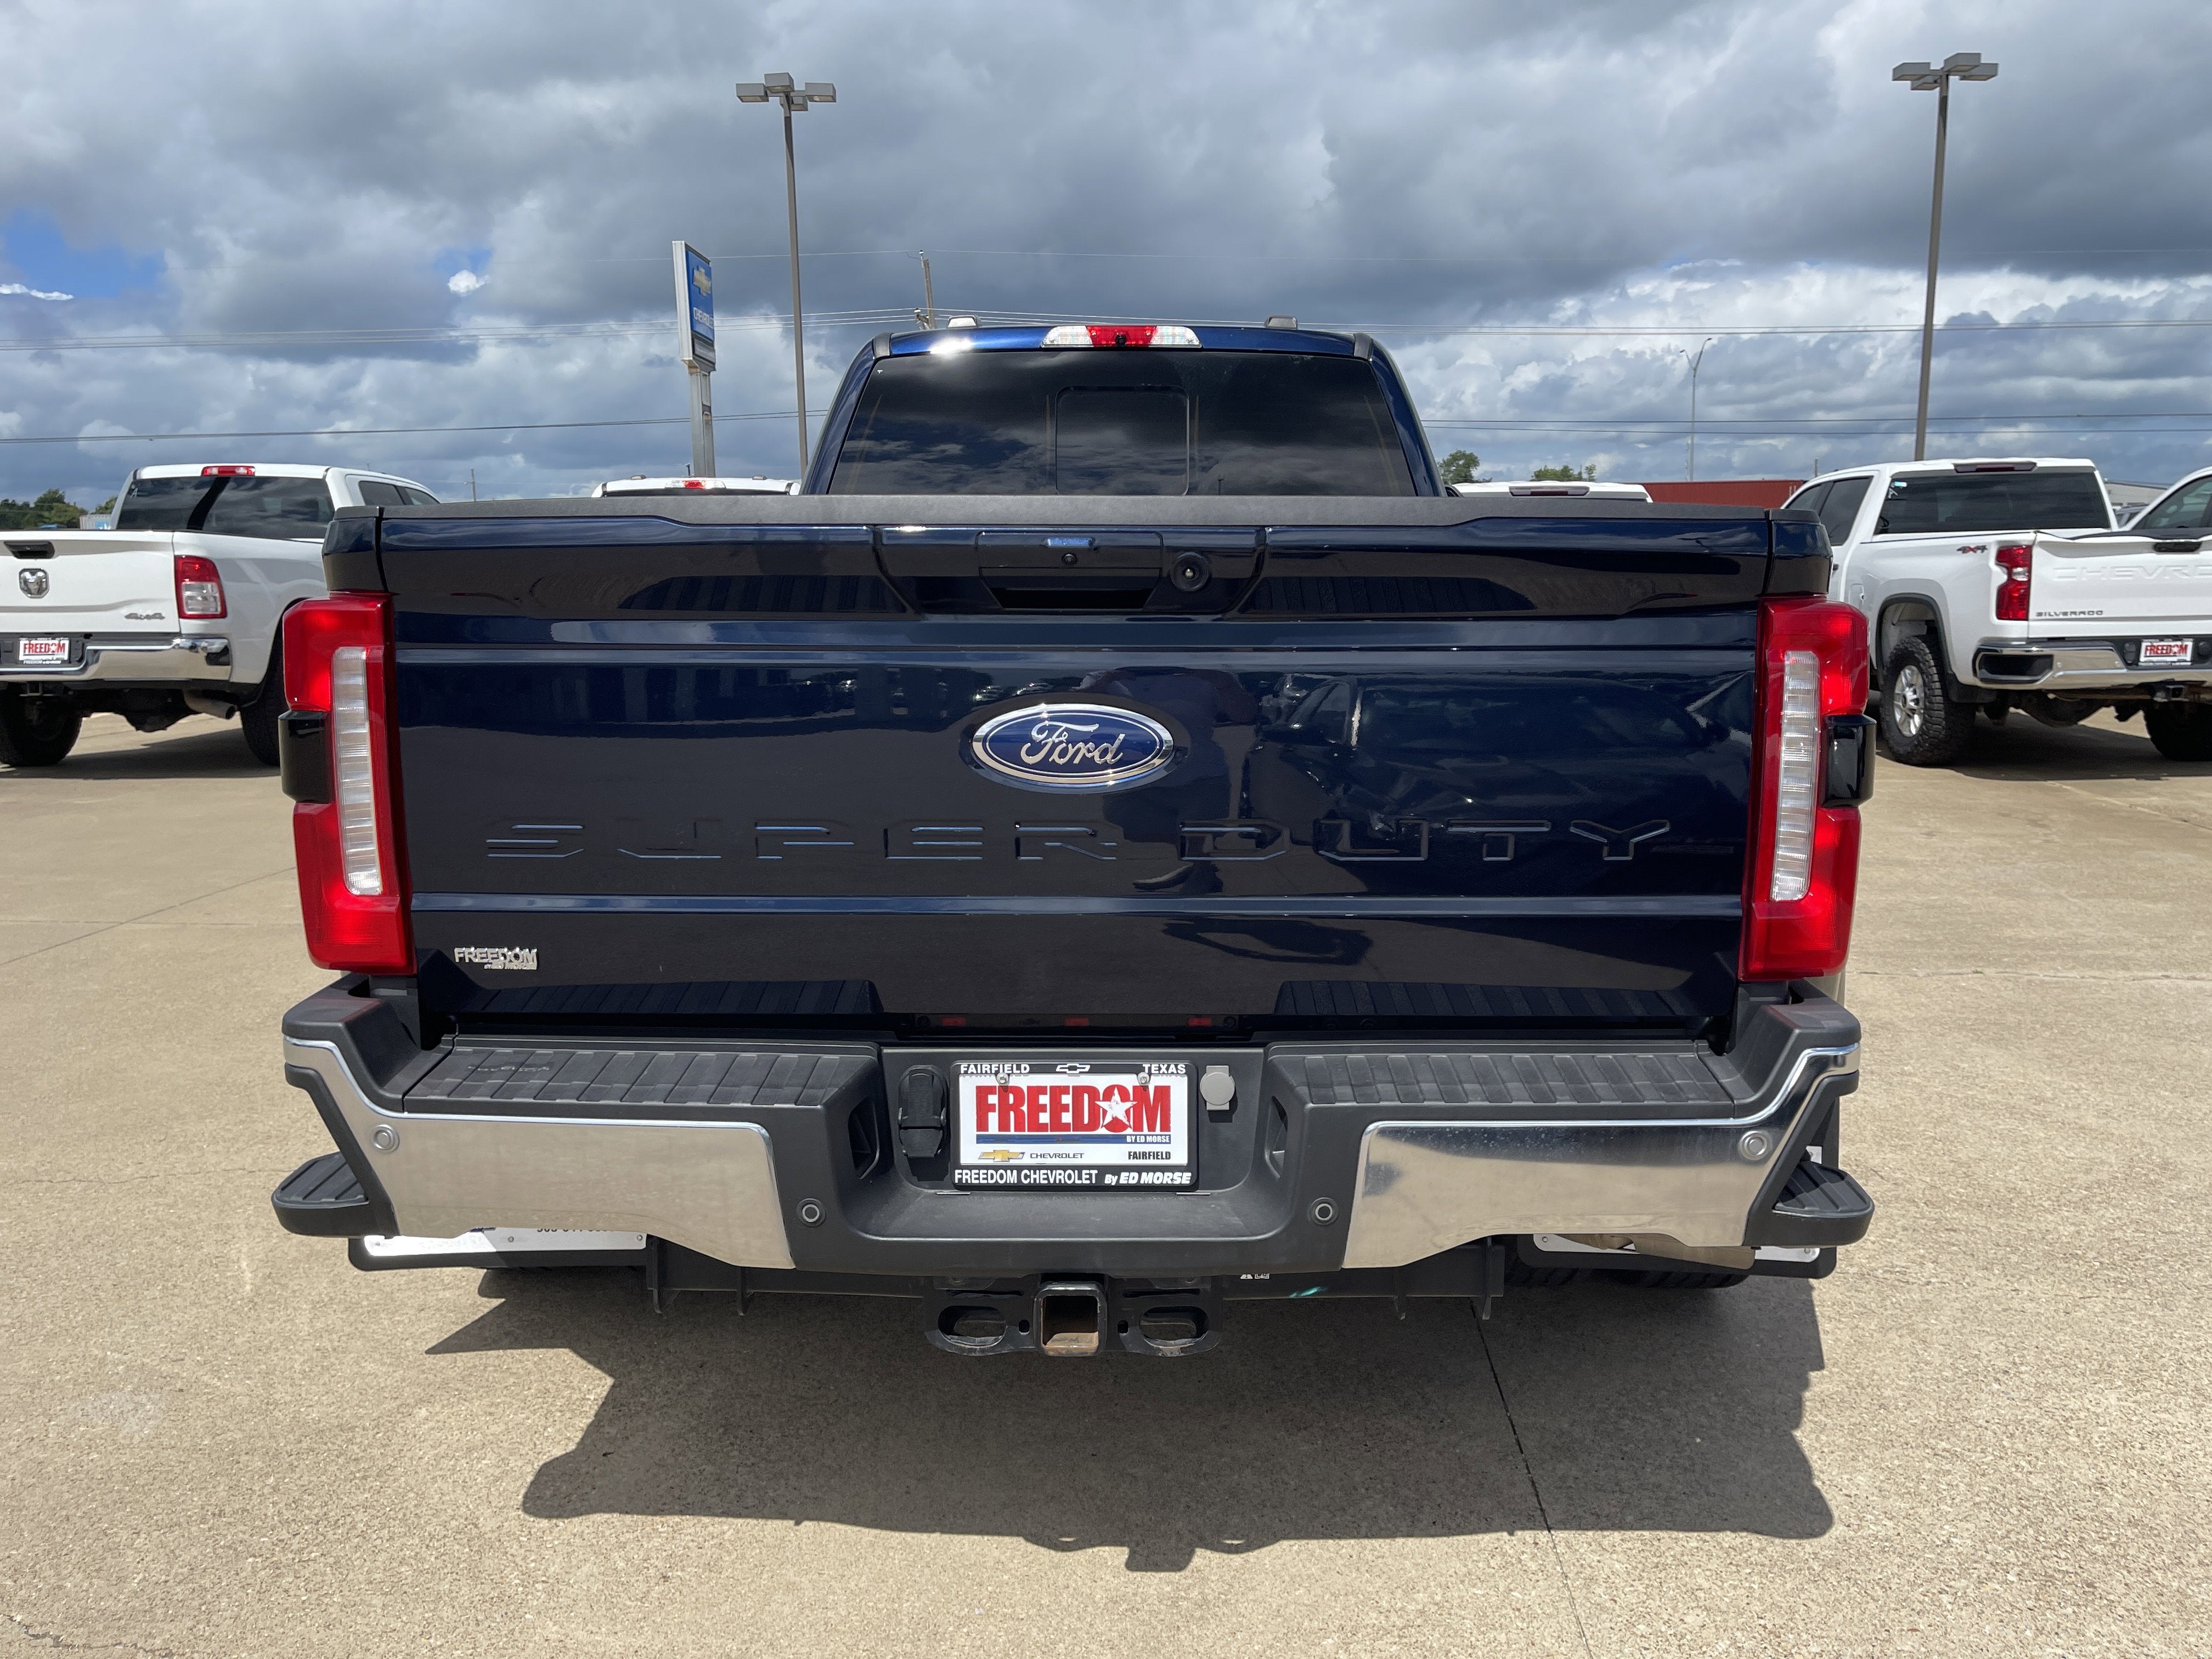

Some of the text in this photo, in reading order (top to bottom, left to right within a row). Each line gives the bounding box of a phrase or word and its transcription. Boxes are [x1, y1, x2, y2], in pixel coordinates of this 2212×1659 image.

[24, 642, 65, 654] FREEDOM
[1020, 721, 1123, 764] Ford
[486, 819, 1671, 861] SUPER DUTY
[454, 947, 537, 962] FREEDOM
[960, 1064, 1186, 1074] FAIRFIELD TEXAS
[975, 1084, 1171, 1133] FREEDOM
[1128, 1151, 1171, 1160] FAIRFIELD
[955, 1170, 1192, 1186] FREEDOM CHEVROLET By ED MORSE
